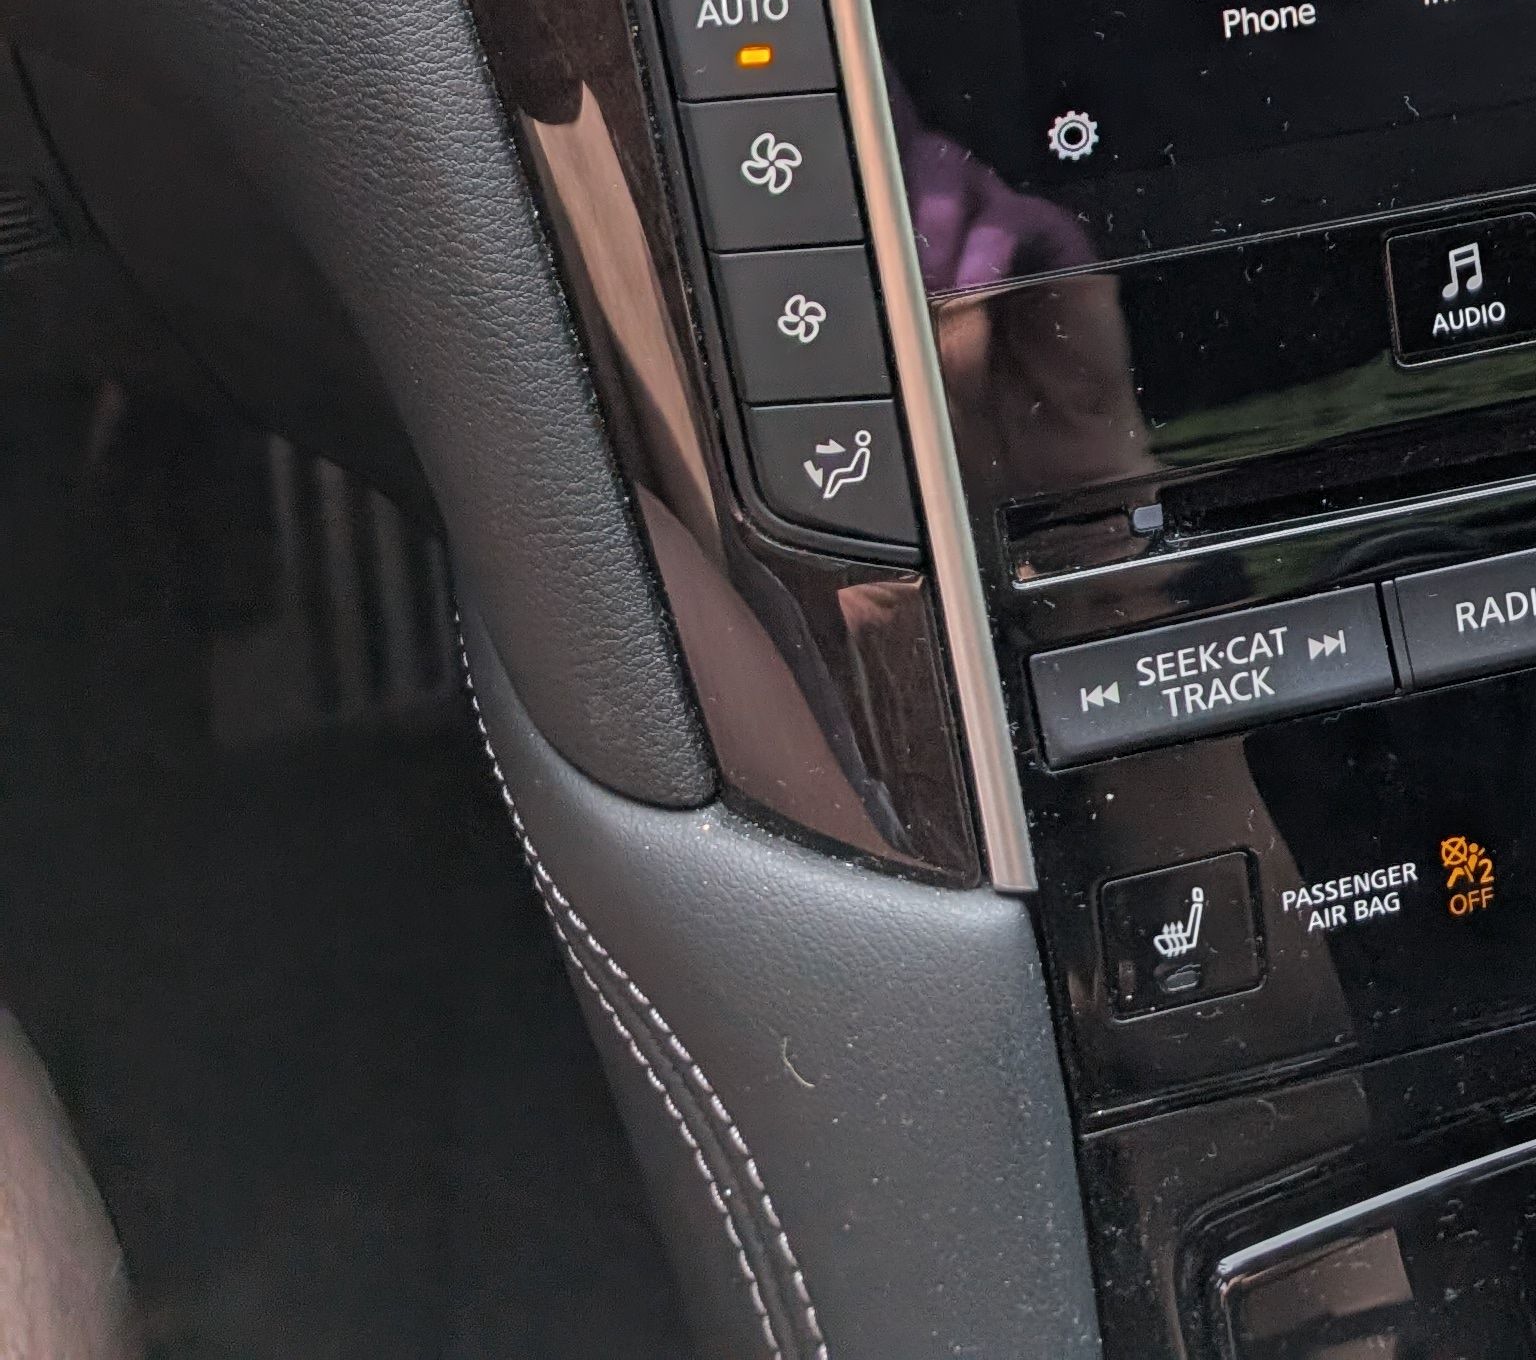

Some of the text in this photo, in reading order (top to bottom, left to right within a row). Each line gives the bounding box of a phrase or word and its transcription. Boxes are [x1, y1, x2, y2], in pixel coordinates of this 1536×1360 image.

[1222, 3, 1317, 39] Phone
[1432, 300, 1506, 335] AUDIO
[1161, 668, 1276, 718] TRACK
[1281, 862, 1418, 912] PASSENGER
[1449, 885, 1495, 915] OFF
[1306, 892, 1401, 933] AIR BAG
